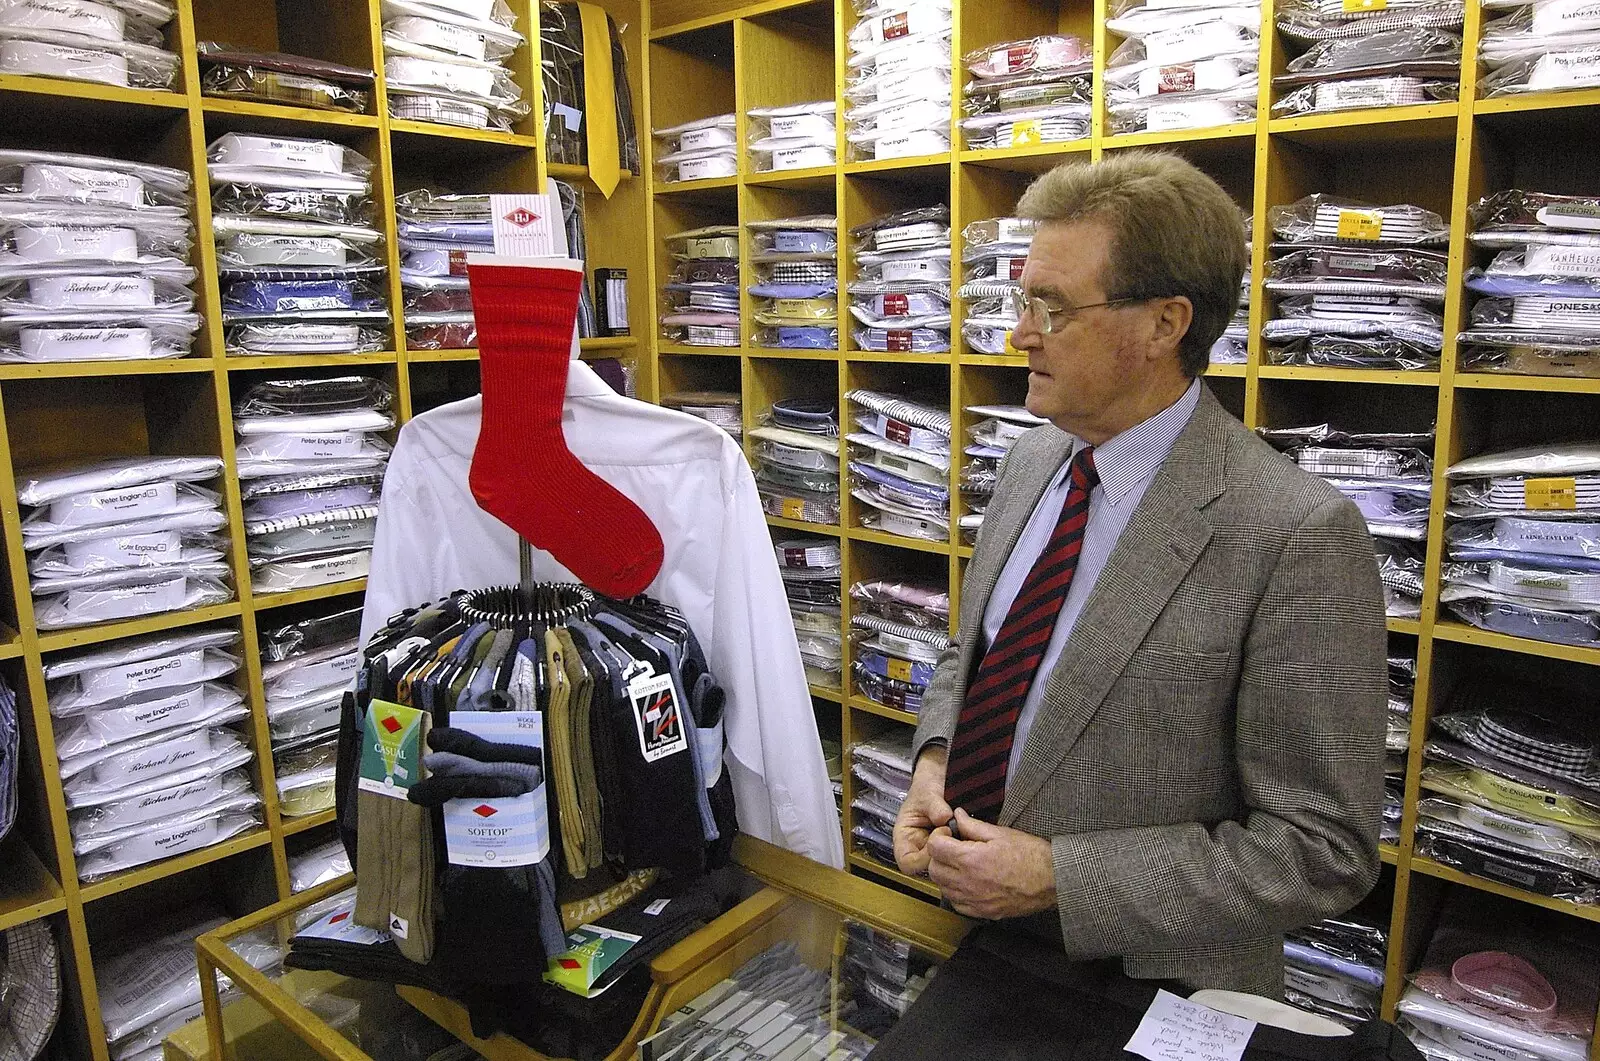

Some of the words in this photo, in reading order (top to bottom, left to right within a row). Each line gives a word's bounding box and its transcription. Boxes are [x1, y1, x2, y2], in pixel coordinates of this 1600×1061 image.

[513, 213, 530, 223] HJ
[1555, 206, 1597, 216] REDFORD
[64, 281, 109, 293] Richard
[111, 281, 140, 293] Jones
[57, 331, 100, 343] Richard
[102, 331, 130, 341] Jones
[300, 437, 316, 445] Peter
[317, 437, 342, 445] England
[100, 495, 119, 505] Peter
[119, 491, 147, 502] England
[326, 558, 352, 569] England
[345, 657, 357, 666] Engl
[126, 669, 144, 679] Peter
[144, 662, 171, 675] England
[634, 684, 656, 696] COTTON
[656, 680, 669, 689] RICH
[135, 712, 152, 722] Peter
[152, 703, 180, 718] England
[373, 743, 407, 760] CASUAL
[129, 758, 167, 773] Richard
[167, 750, 196, 764] Jones
[138, 792, 179, 808] Richard
[180, 785, 208, 799] Jones
[1509, 788, 1543, 801] ENGLAND
[154, 837, 171, 847] Peter
[171, 828, 198, 841] England
[1457, 1035, 1477, 1045] Peter
[1476, 1040, 1507, 1055] England
